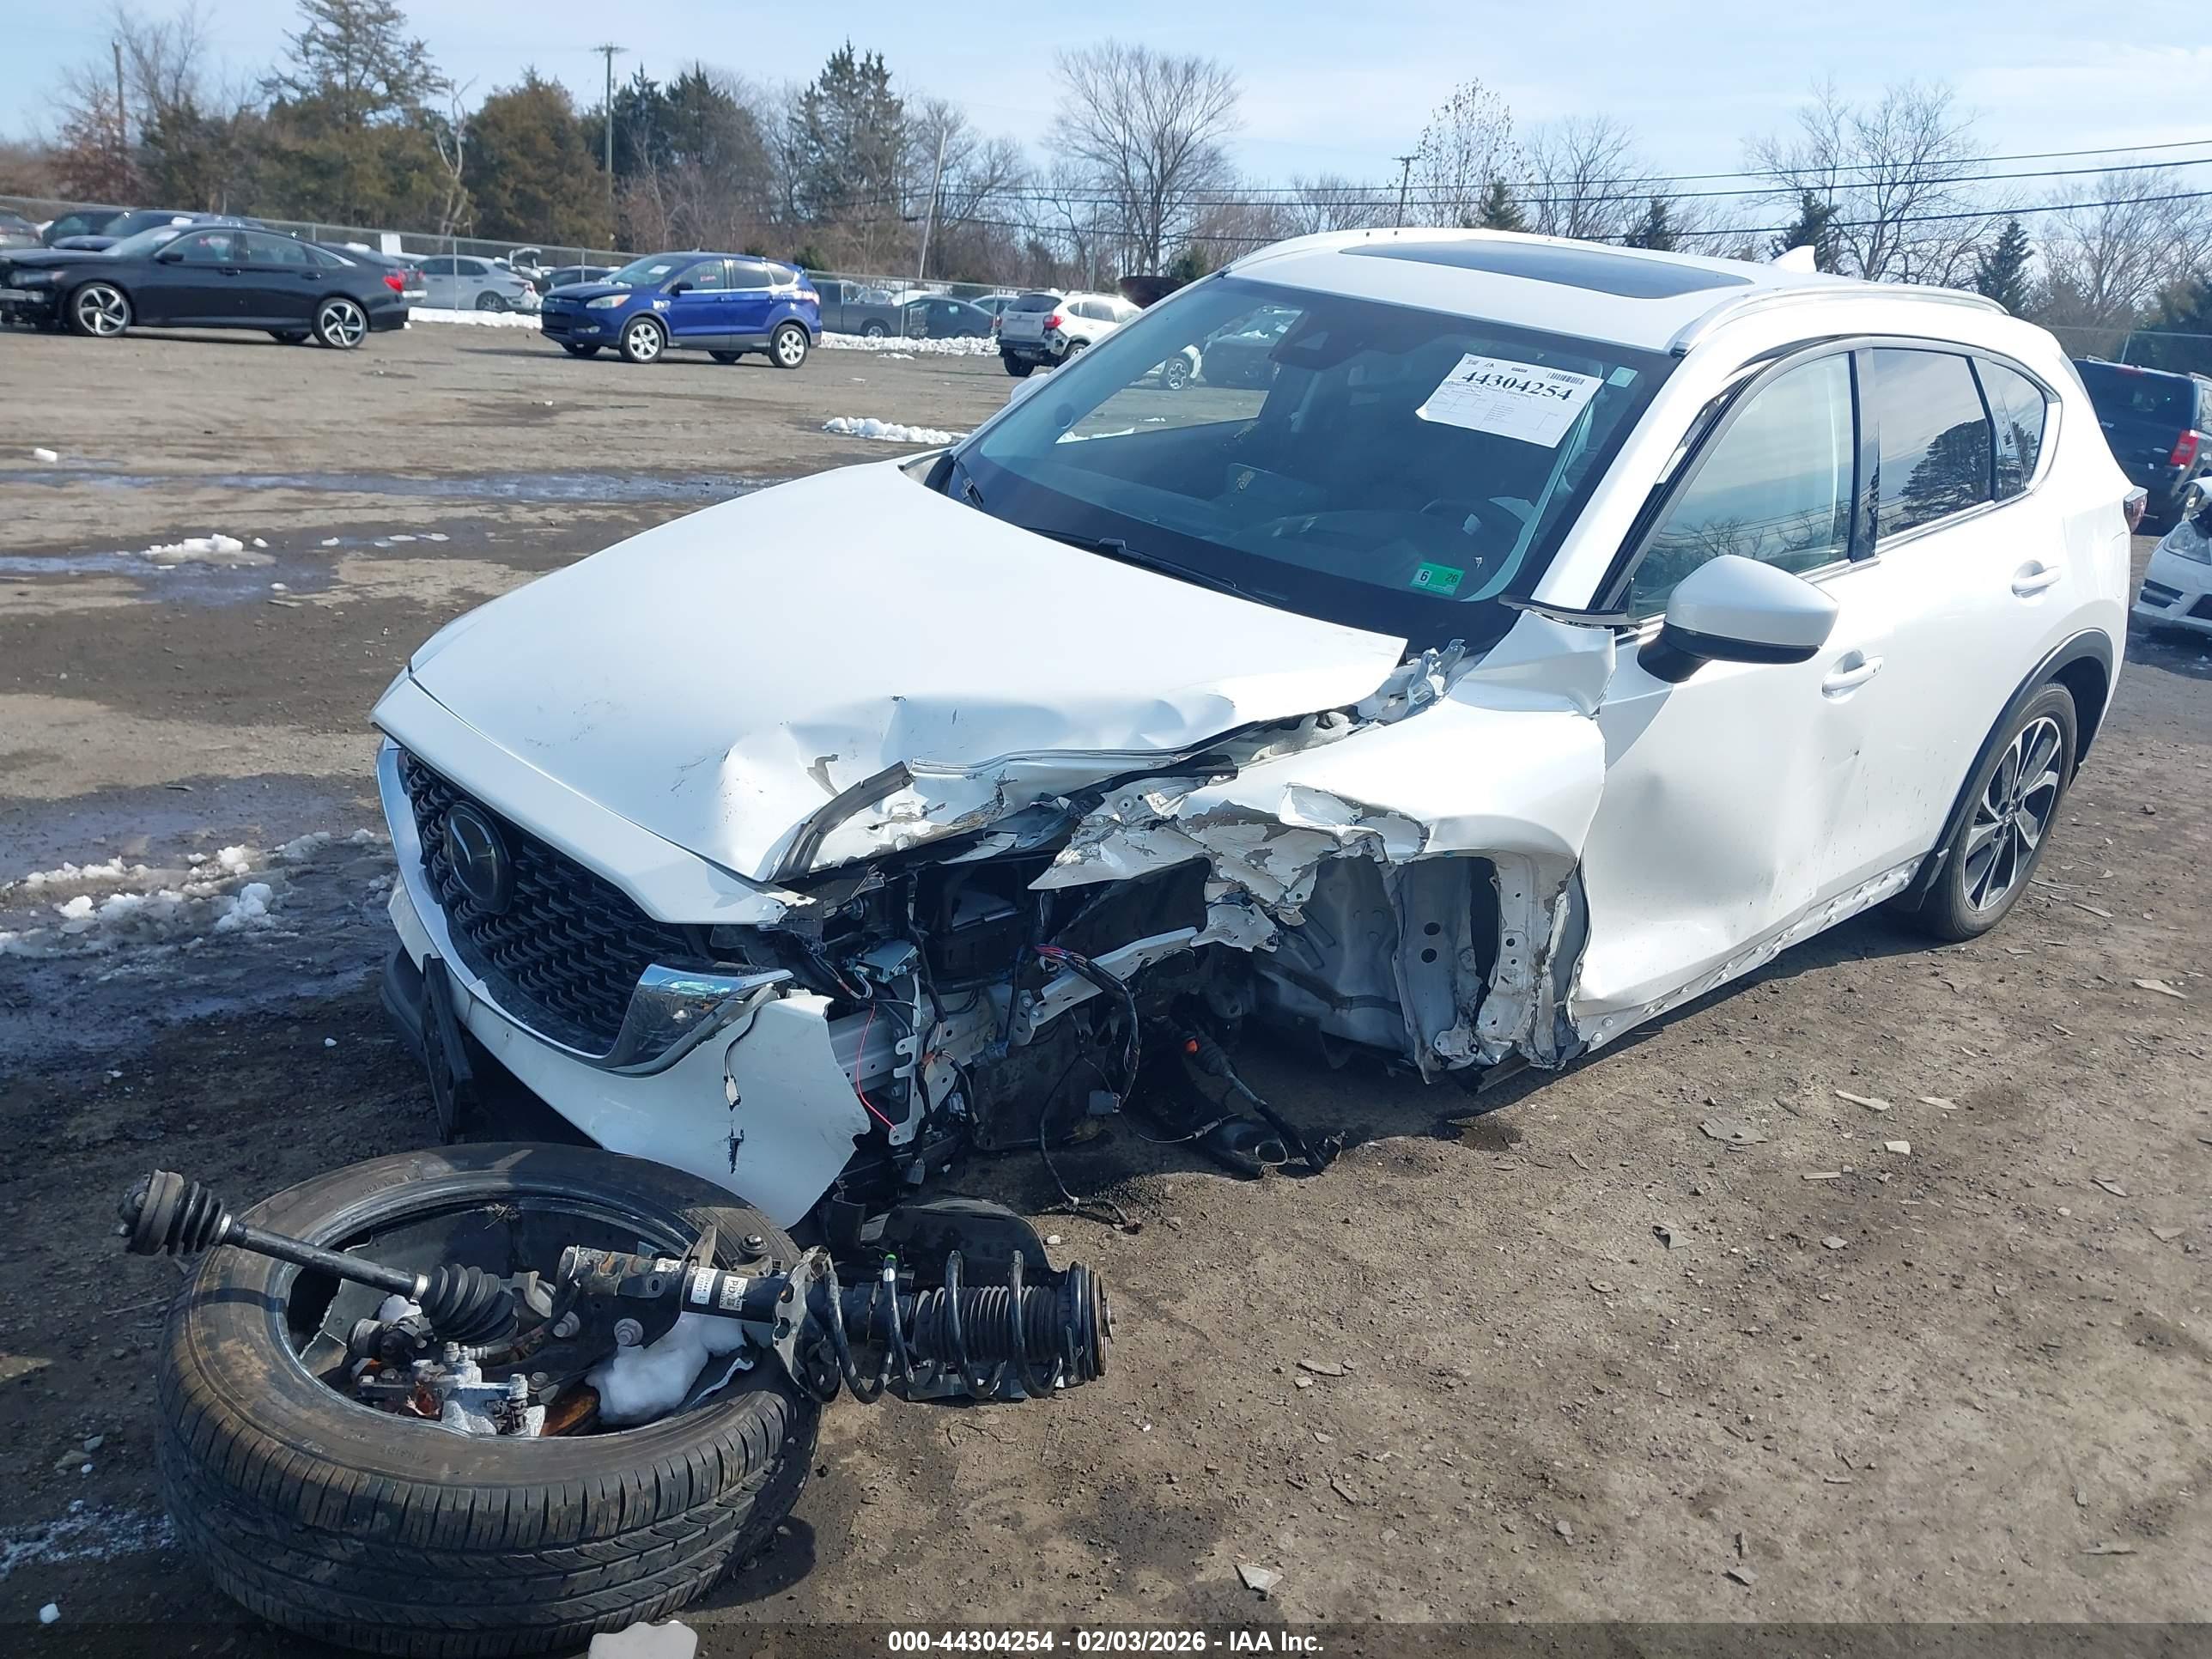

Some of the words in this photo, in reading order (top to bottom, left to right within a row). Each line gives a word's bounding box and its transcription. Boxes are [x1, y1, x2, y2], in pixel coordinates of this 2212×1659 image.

[1462, 371, 1573, 400] 44304254
[1420, 570, 1430, 581] 6
[1445, 573, 1459, 584] 26
